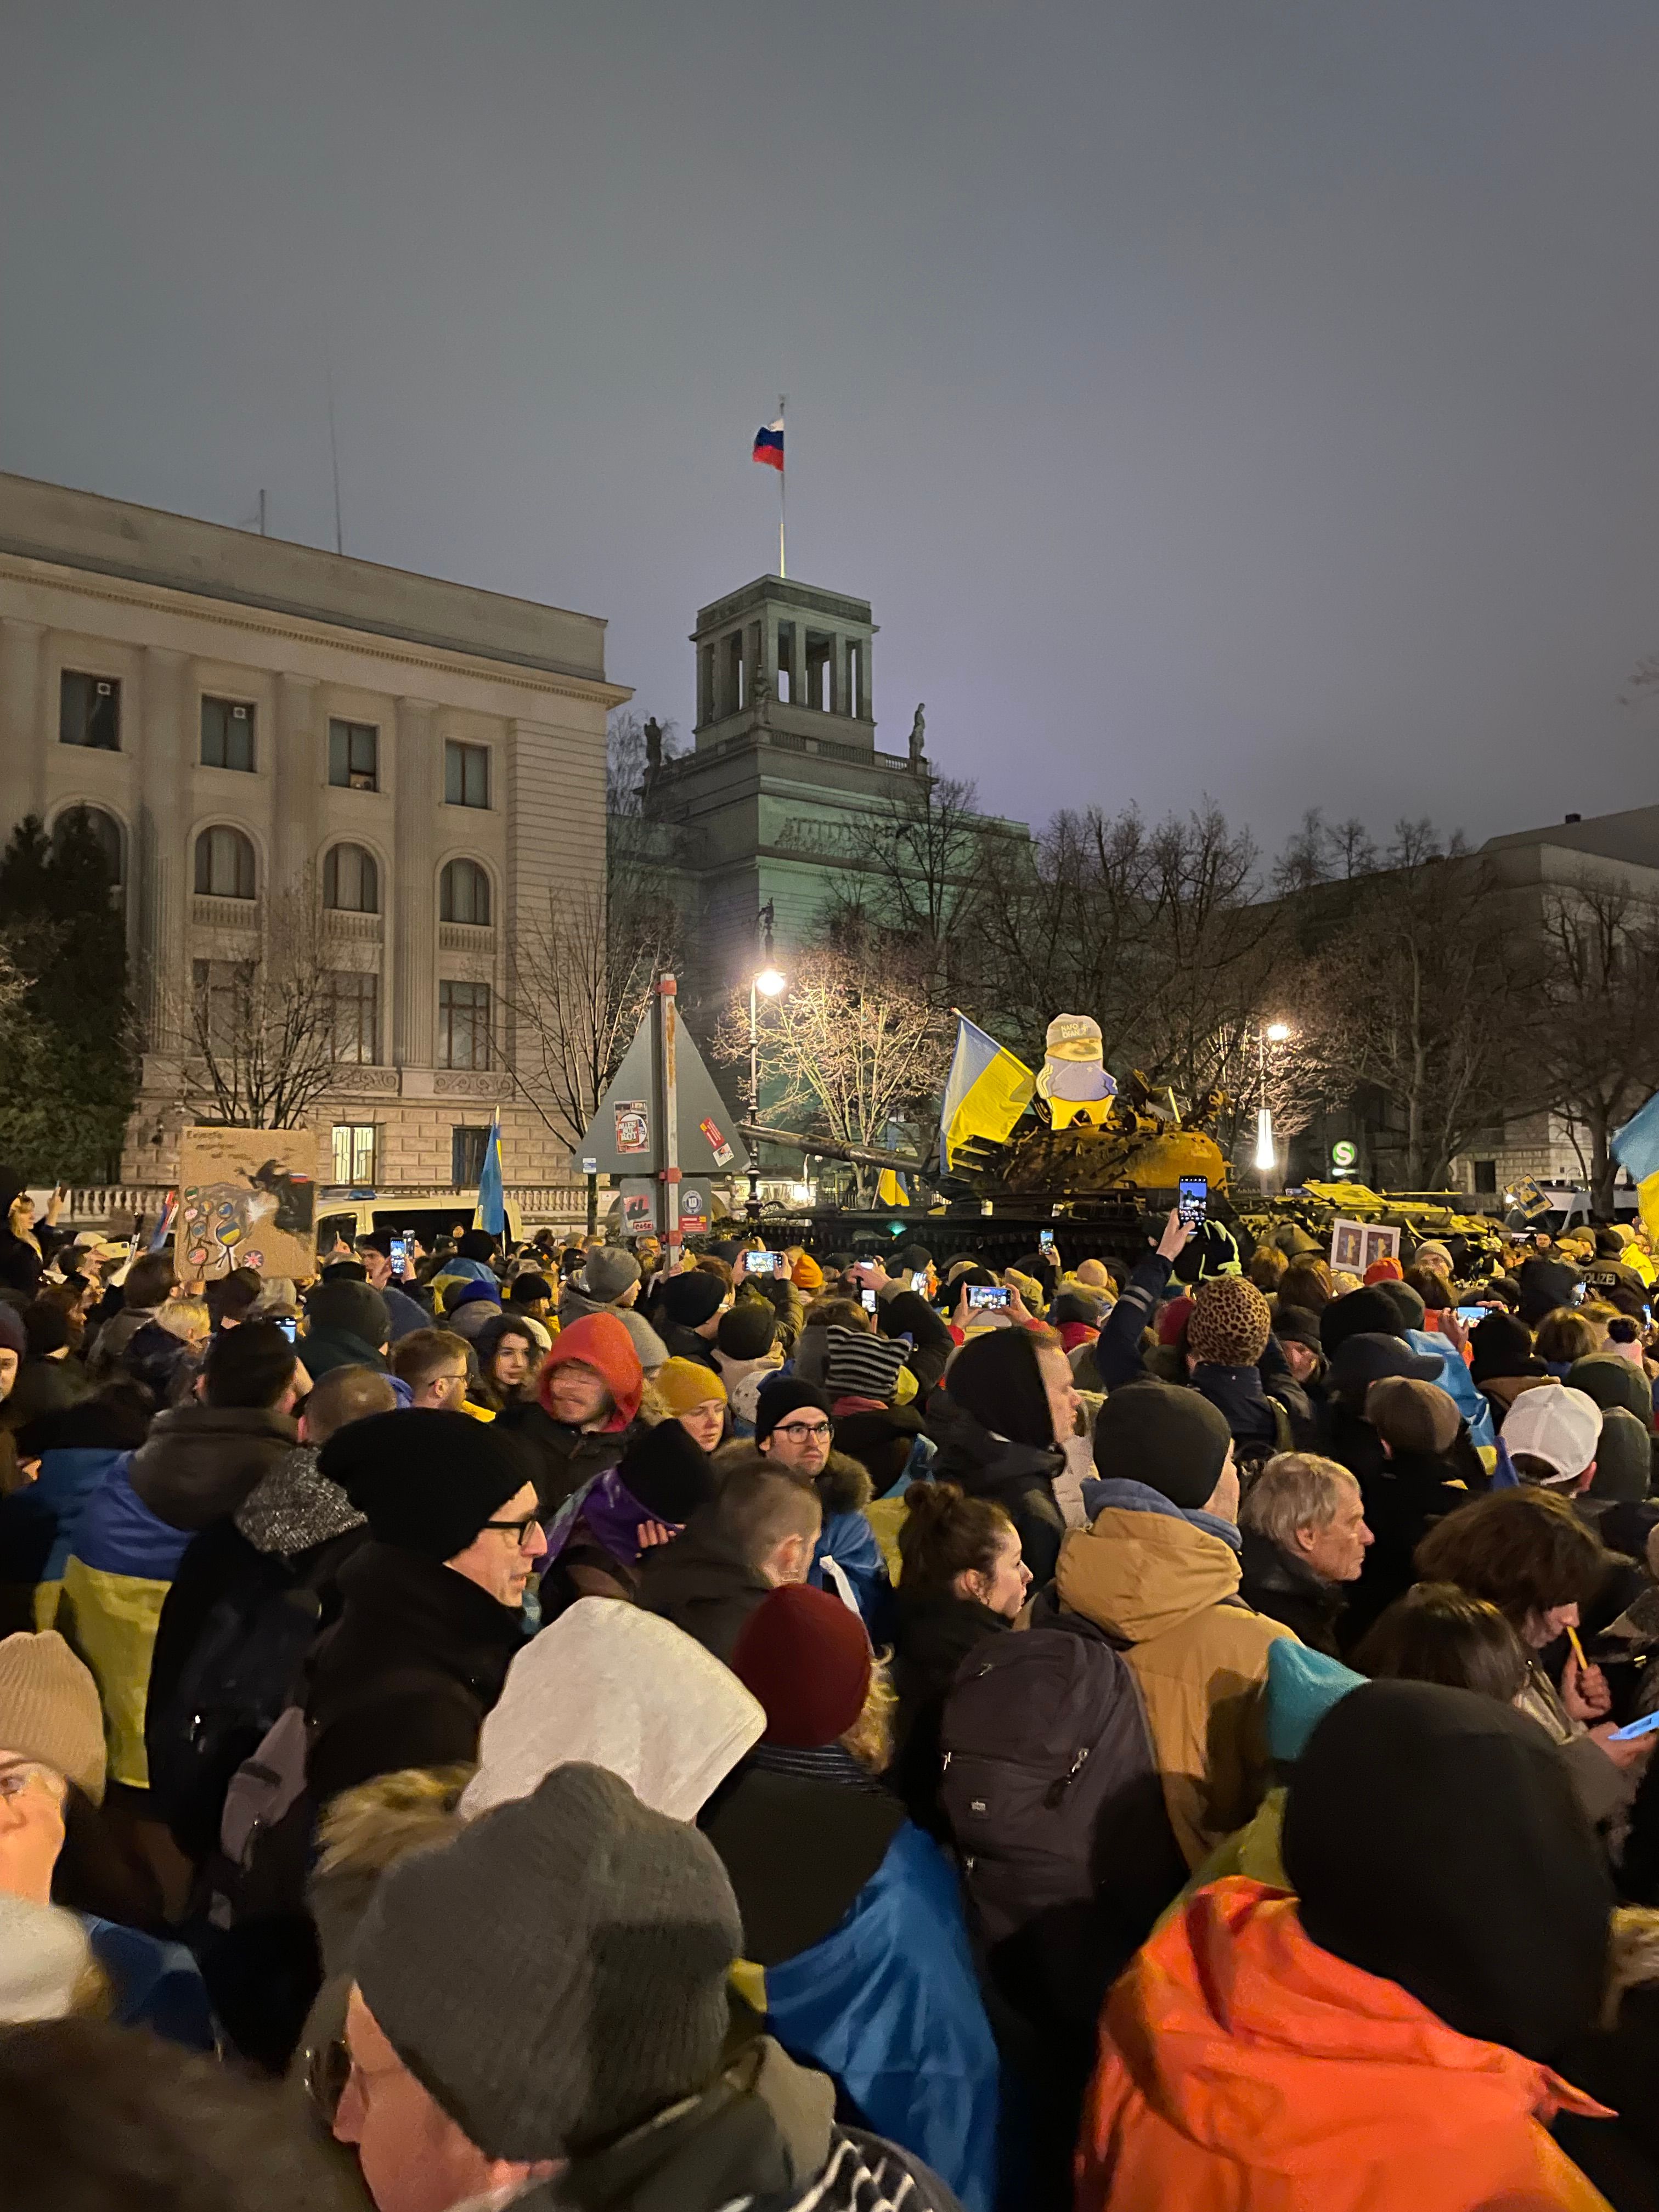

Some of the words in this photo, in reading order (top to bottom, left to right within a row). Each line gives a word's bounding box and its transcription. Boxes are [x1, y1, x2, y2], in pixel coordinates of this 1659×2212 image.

[1061, 1023, 1078, 1031] NAFO
[620, 1131, 637, 1141] ROT
[1336, 1143, 1352, 1166] S
[1583, 1272, 1616, 1286] OLIZEI
